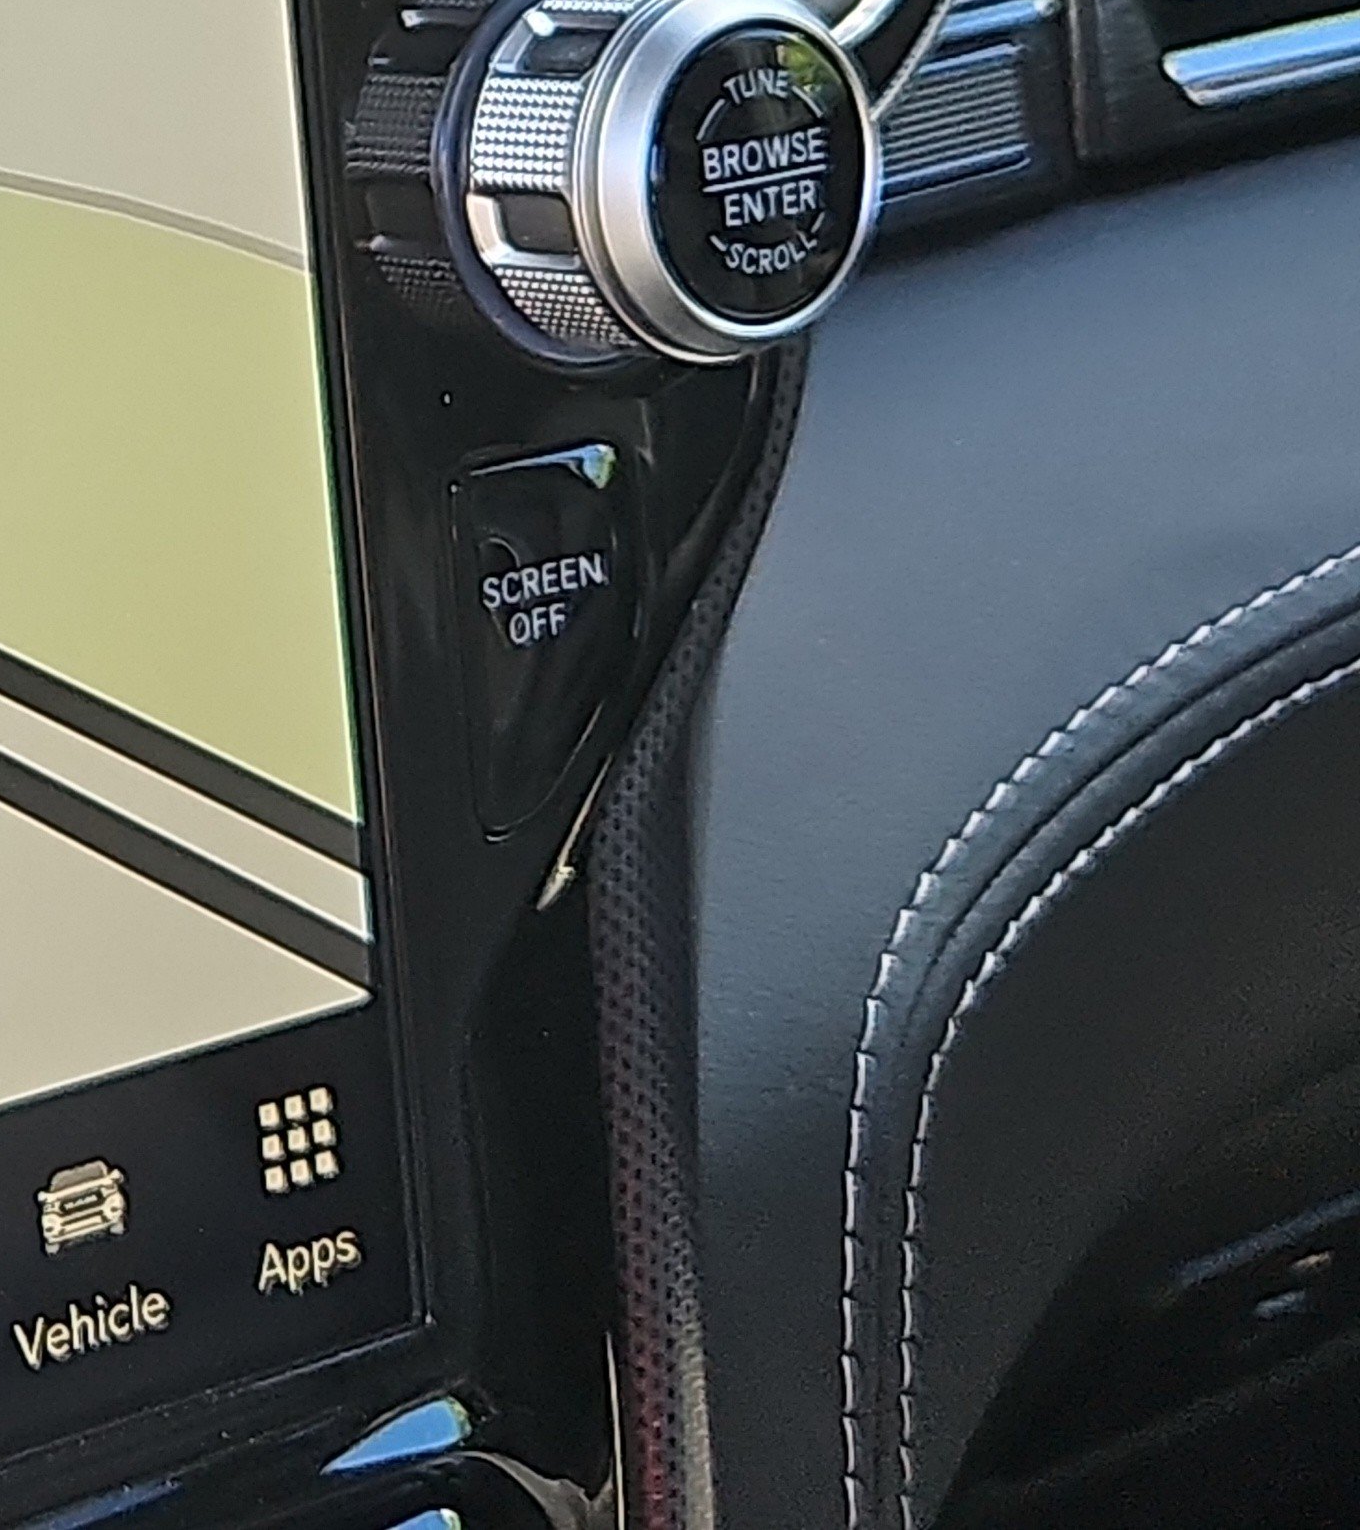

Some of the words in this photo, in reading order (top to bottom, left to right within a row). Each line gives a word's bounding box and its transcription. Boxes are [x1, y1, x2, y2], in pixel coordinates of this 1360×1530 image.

[724, 70, 788, 104] TUNE
[702, 127, 825, 178] BROWSE
[723, 182, 817, 227] ENTER
[725, 234, 818, 274] SCROLL
[483, 554, 602, 608] SCREEN
[508, 604, 567, 646] OFF
[258, 1227, 362, 1292] Apps
[13, 1285, 170, 1370] Vehicle
